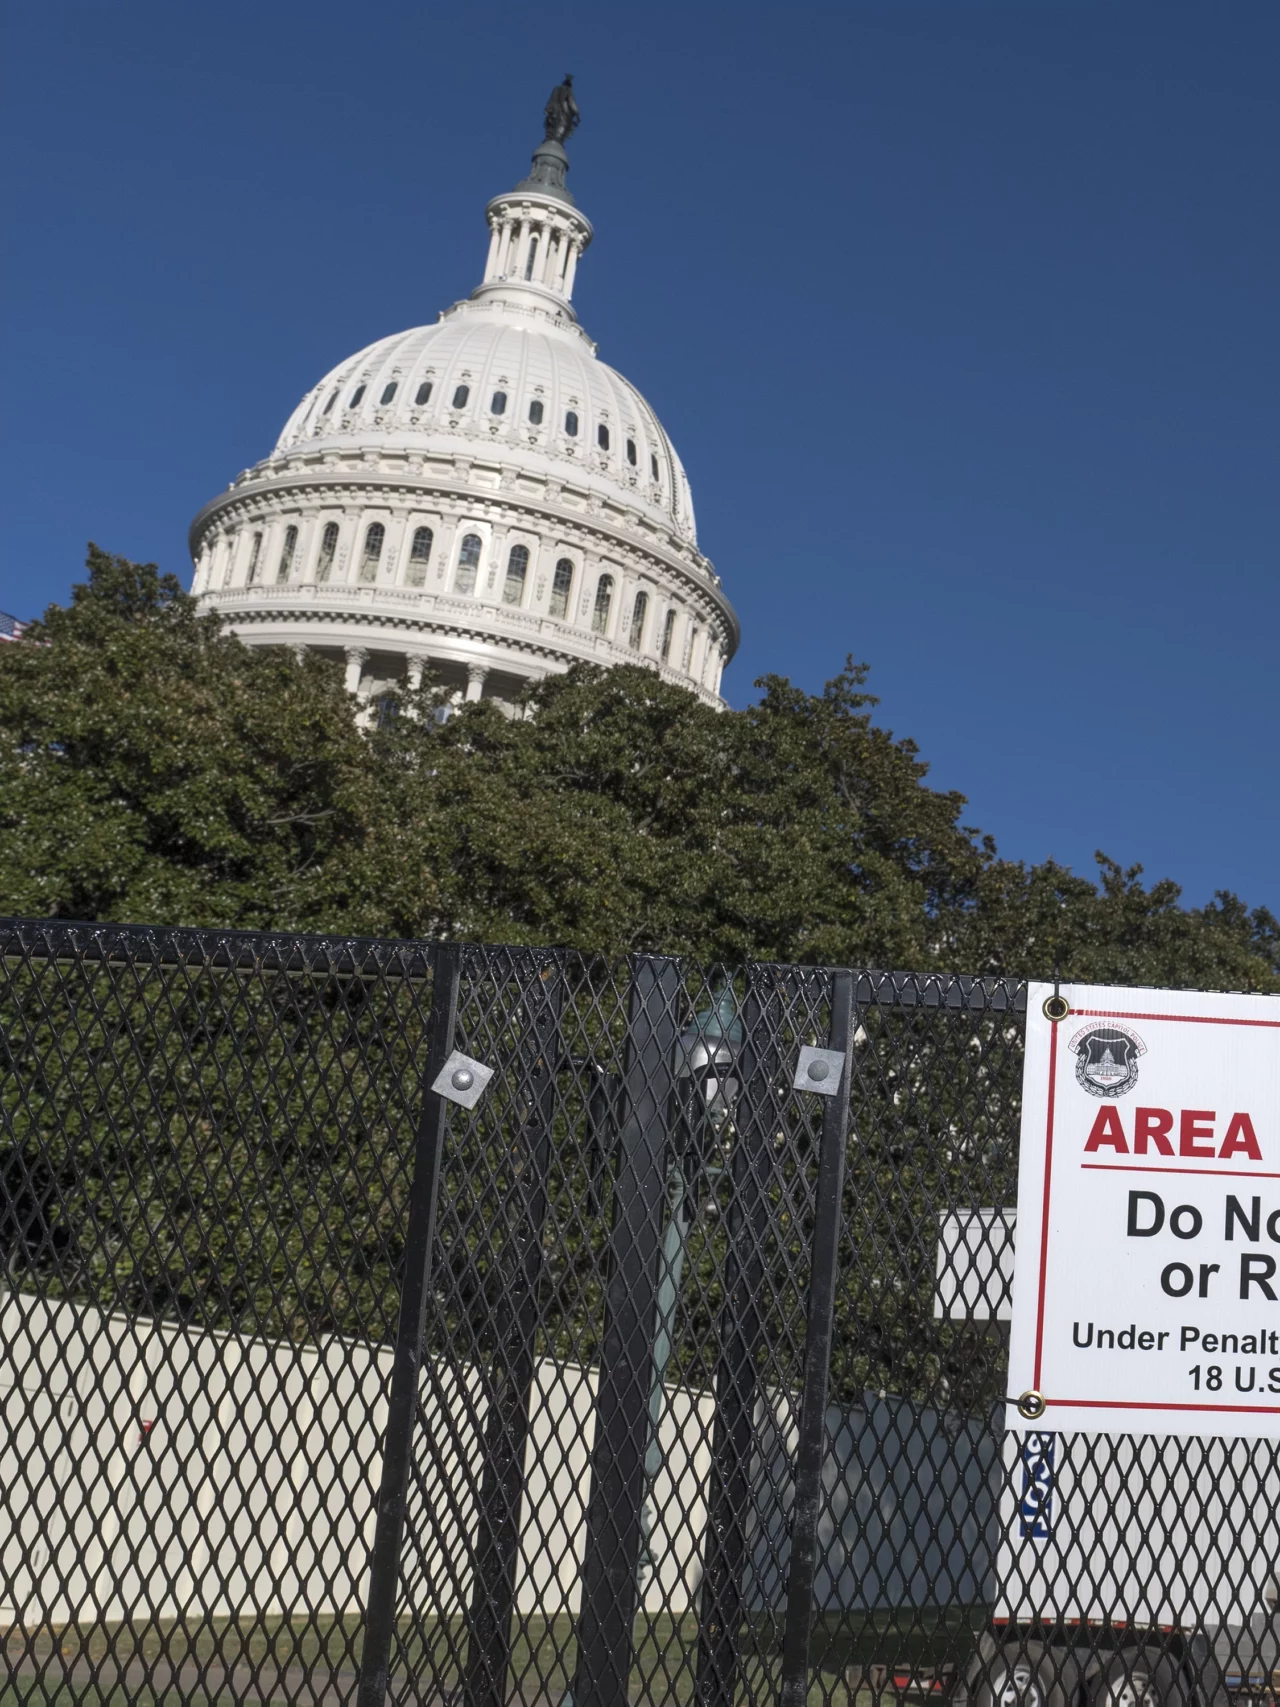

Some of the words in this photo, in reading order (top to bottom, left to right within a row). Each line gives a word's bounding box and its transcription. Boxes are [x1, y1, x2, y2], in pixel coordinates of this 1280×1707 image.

[1070, 1030, 1087, 1048] UNITED
[1086, 1022, 1106, 1033] STATES
[1107, 1022, 1130, 1034] CAPITOL
[1130, 1033, 1145, 1051] POLICE
[1083, 1105, 1263, 1161] AREA
[1126, 1190, 1203, 1240] Do
[1160, 1261, 1221, 1298] or
[1072, 1321, 1170, 1352] Under
[1188, 1364, 1223, 1392] 18
